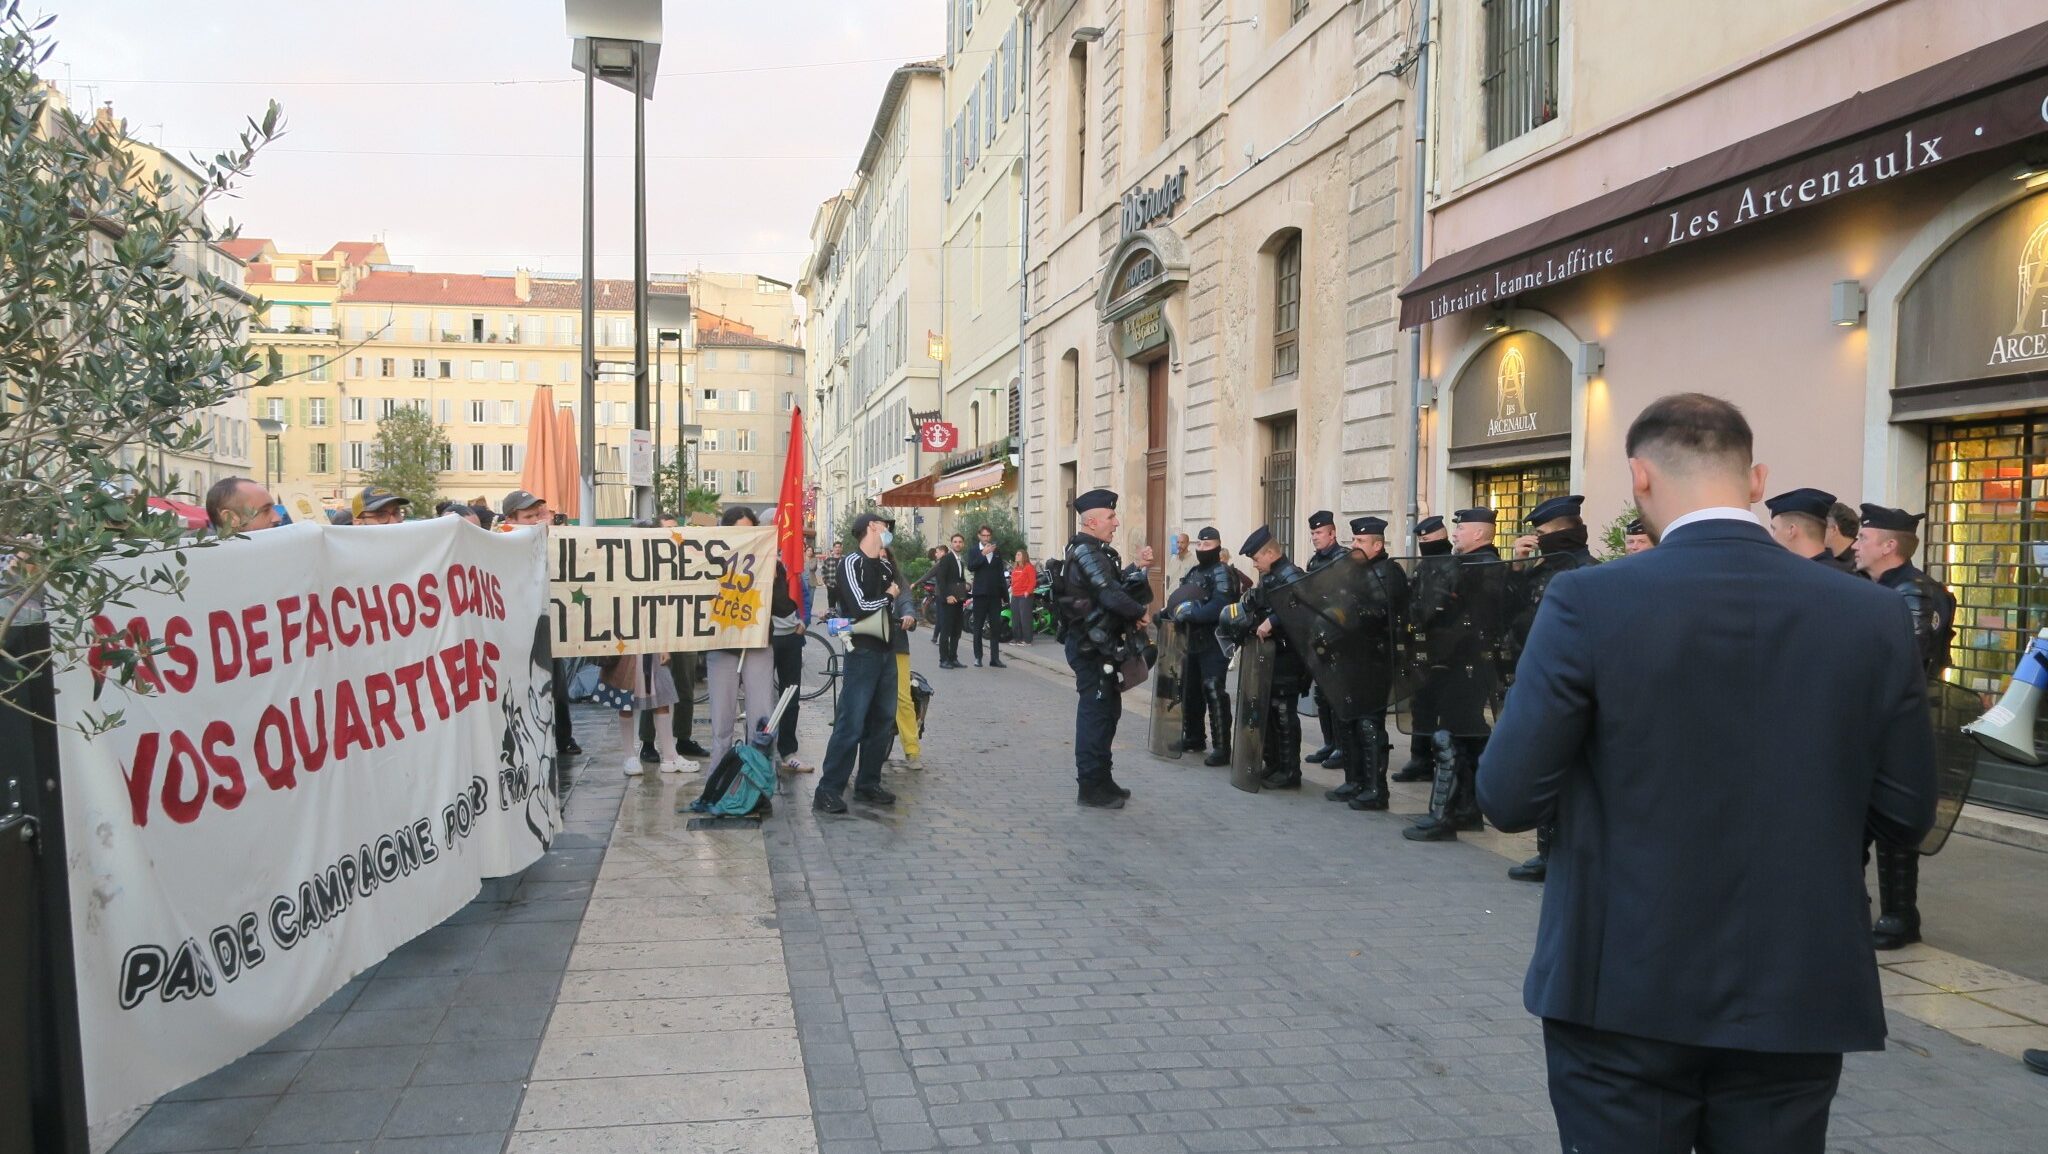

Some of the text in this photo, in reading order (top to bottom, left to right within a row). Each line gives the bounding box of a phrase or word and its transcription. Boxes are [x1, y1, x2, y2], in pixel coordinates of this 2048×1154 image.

[1430, 130, 1943, 320] Librairie Jeanne Laffitte Les Arcenaulx
[1986, 333, 2048, 366] ARCE
[1487, 412, 1538, 437] ARCENAULX
[550, 537, 731, 583] ULTURES
[719, 551, 756, 593] 13
[208, 603, 273, 684] DE
[276, 572, 442, 665] FACHOS
[447, 563, 507, 622] DANS
[583, 594, 718, 642] LUTTE
[711, 591, 753, 622] très
[118, 719, 248, 831] VOS
[209, 911, 266, 984] DE
[268, 816, 440, 951] CAMPAGNE
